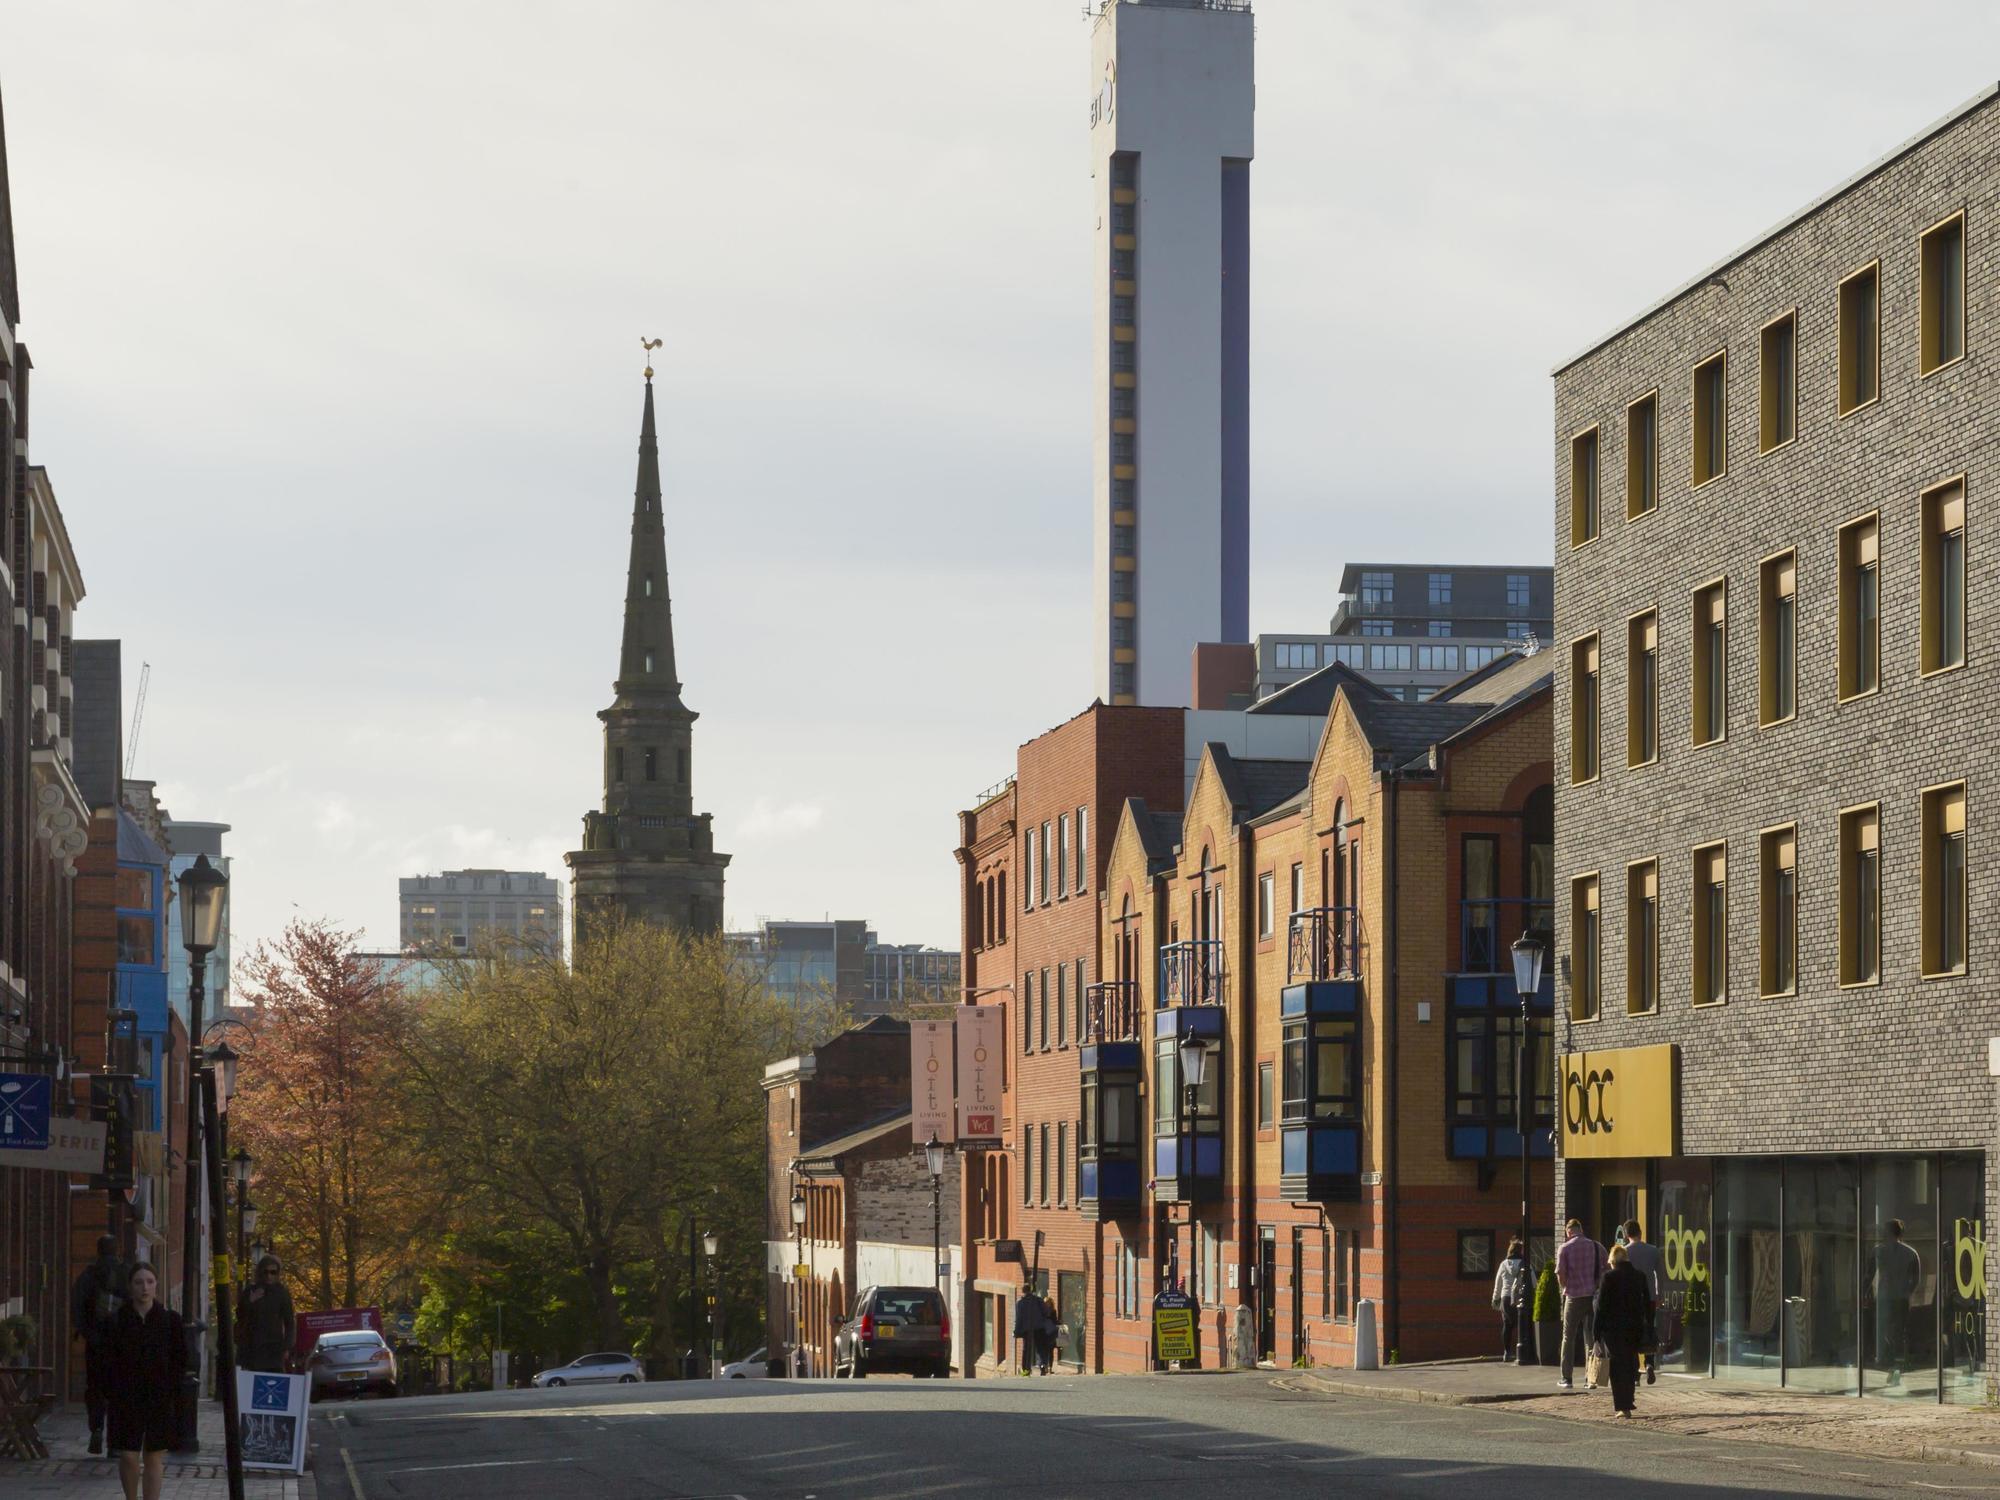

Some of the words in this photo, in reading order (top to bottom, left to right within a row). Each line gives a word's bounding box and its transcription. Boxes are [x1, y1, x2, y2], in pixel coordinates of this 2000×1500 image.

[1565, 1053, 1615, 1136] bloc
[919, 1111, 948, 1119] LIVING
[966, 1104, 996, 1112] LIVING
[1663, 1213, 1706, 1283] bloc
[1664, 1290, 1707, 1313] HOTELS
